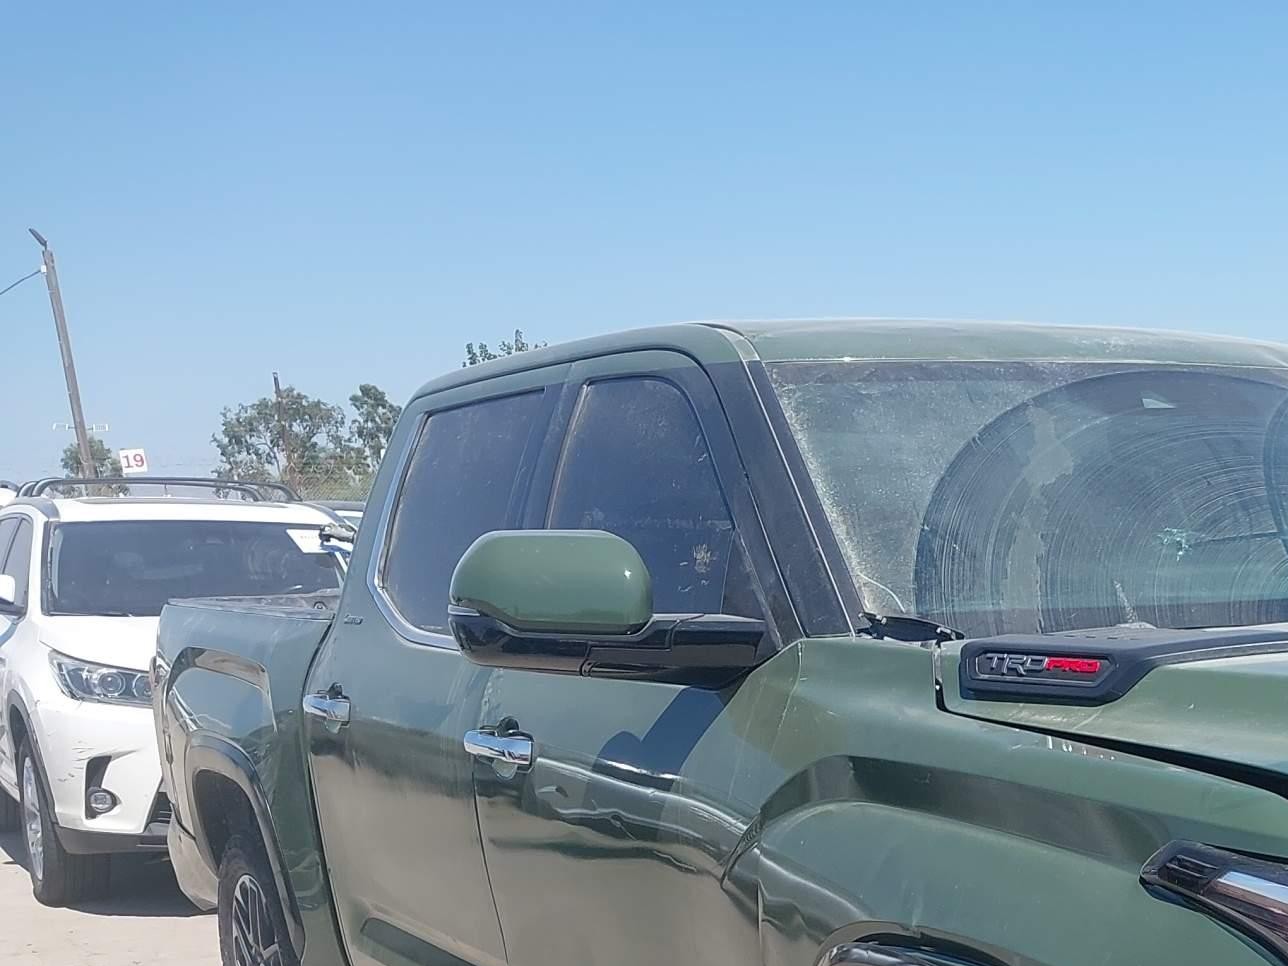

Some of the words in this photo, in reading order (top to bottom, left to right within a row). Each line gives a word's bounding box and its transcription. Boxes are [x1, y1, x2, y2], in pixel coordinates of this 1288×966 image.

[122, 453, 145, 469] 19
[986, 653, 1047, 676] TRD
[1045, 656, 1100, 673] PRO
